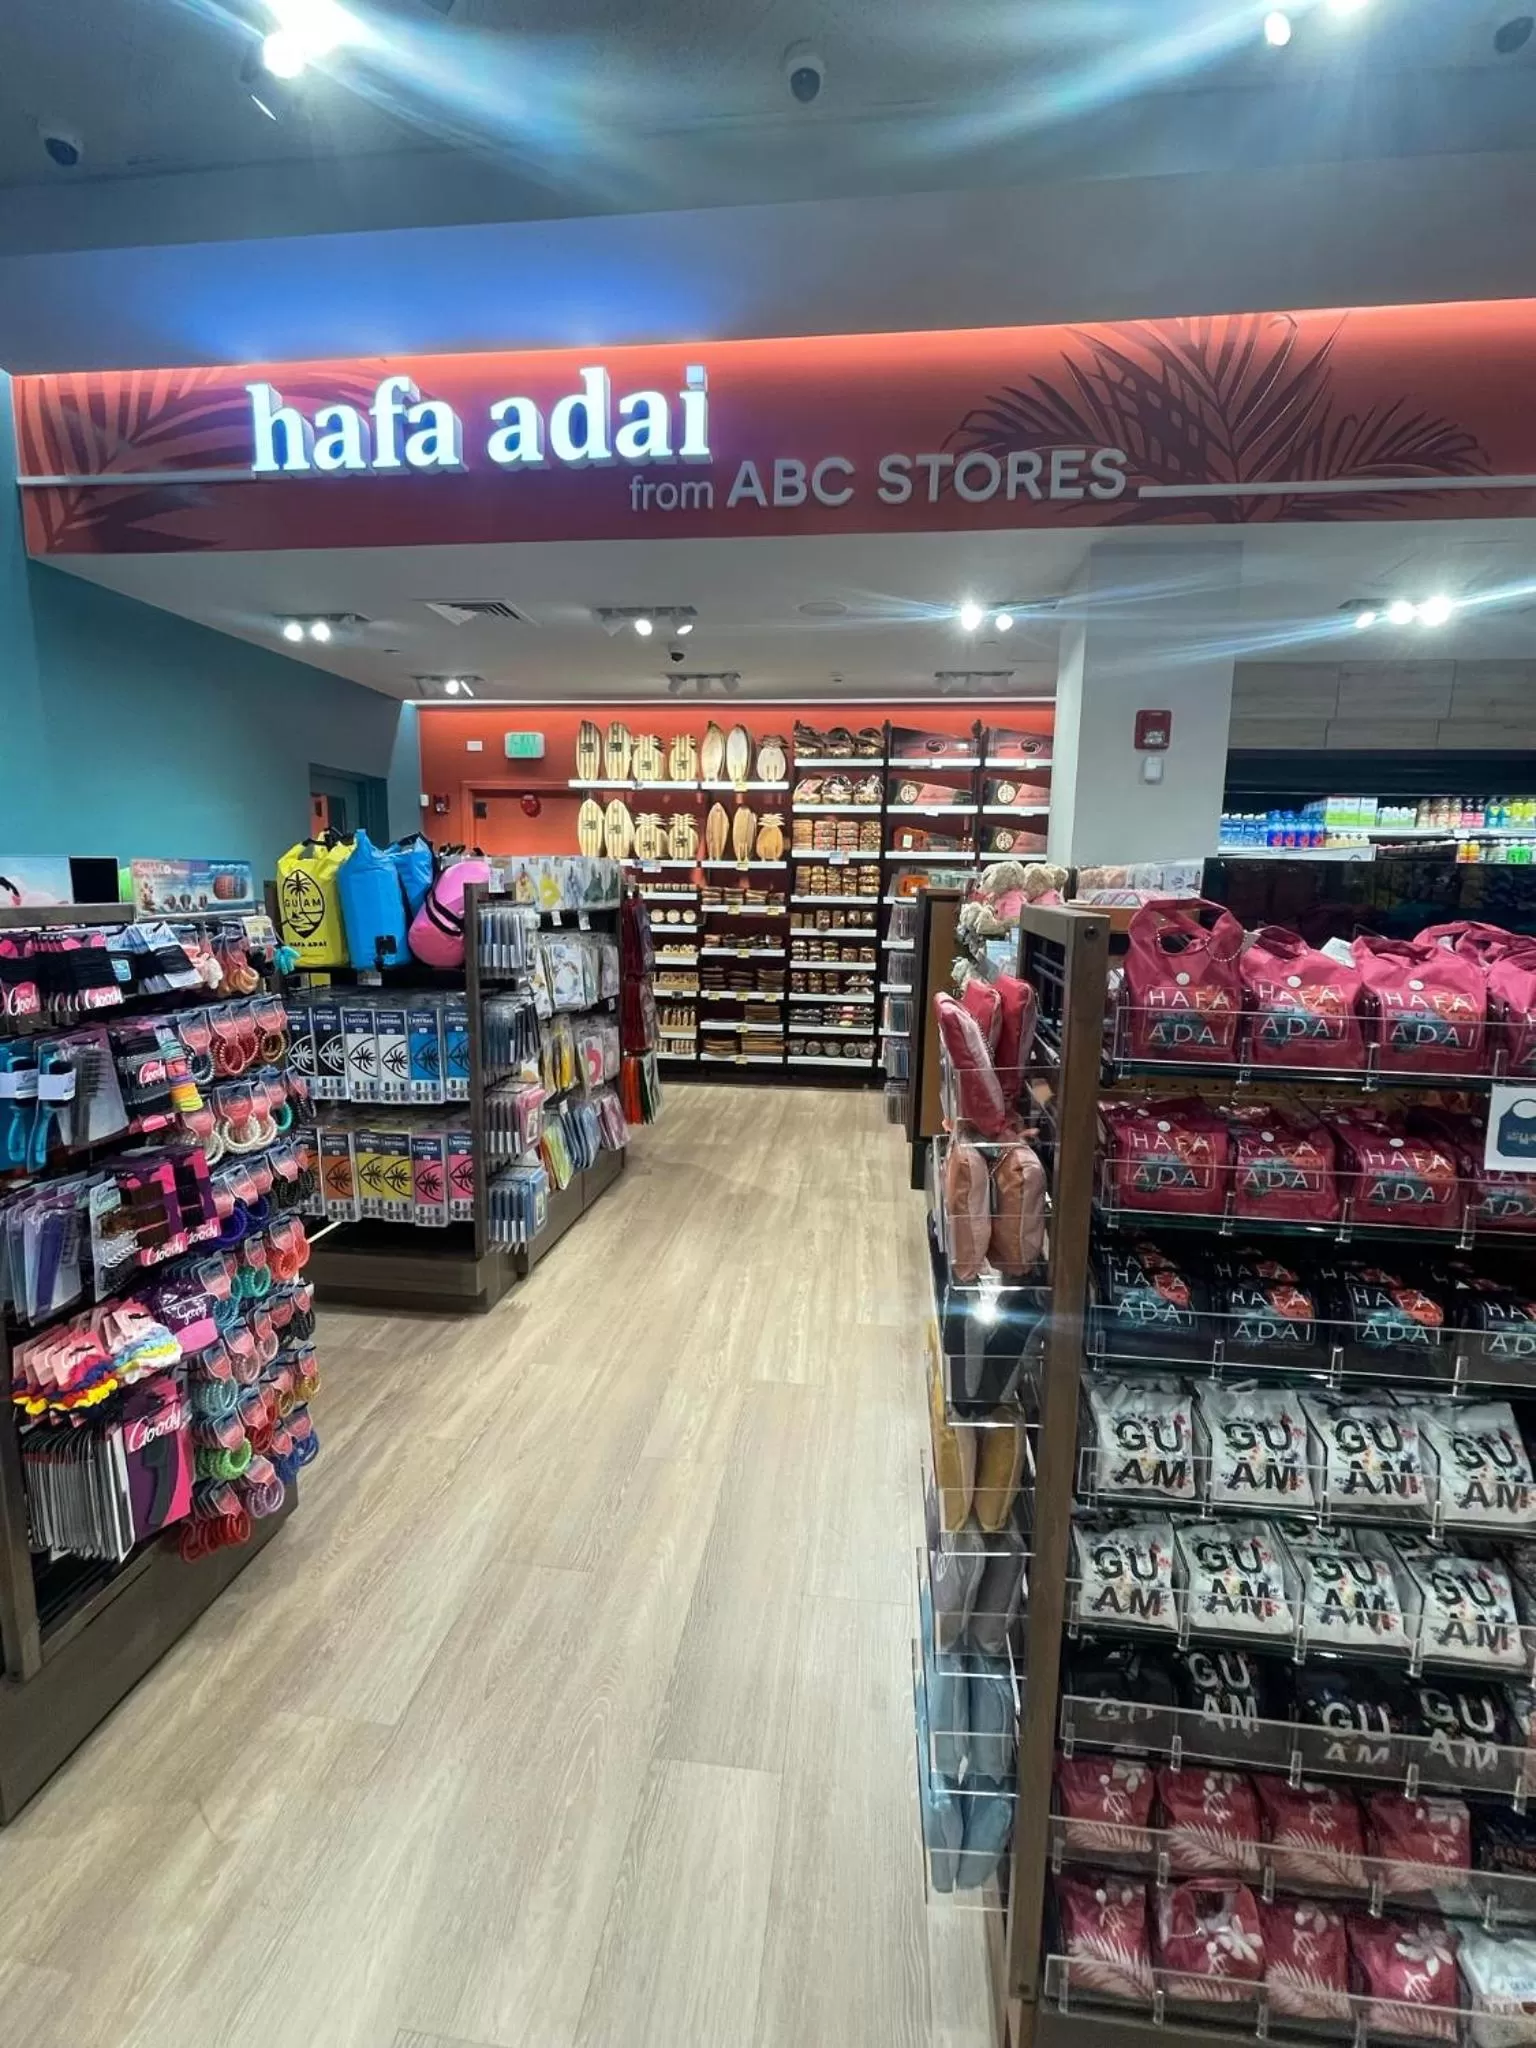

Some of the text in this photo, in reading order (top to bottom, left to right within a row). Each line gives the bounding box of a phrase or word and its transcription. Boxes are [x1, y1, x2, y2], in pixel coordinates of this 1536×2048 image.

[246, 365, 712, 475] hafa adai
[630, 448, 1128, 512] from ABC STORES
[284, 898, 322, 909] GUAM
[1149, 990, 1231, 1010] HAFA
[1258, 984, 1340, 1008] HAFA
[1384, 991, 1473, 1013] HAFA
[1148, 1023, 1229, 1046] ADAI
[1260, 1016, 1343, 1038] ADAI
[1389, 1023, 1475, 1047] ADAI
[1132, 1132, 1211, 1154] HAFA
[1132, 1167, 1210, 1188] ADAI
[1366, 1149, 1453, 1174] HAFA
[1243, 1170, 1321, 1190] ADAI
[1367, 1181, 1452, 1204] ADAI
[1117, 1299, 1194, 1326] ADAI
[1231, 1289, 1311, 1309] HAFA
[1352, 1287, 1437, 1311] HAFA
[1233, 1321, 1312, 1342] ADAI
[1362, 1321, 1443, 1346] ADAI
[129, 1402, 181, 1453] Goody
[1116, 1419, 1184, 1451] GU
[1223, 1418, 1293, 1450] GU
[1335, 1415, 1404, 1454] GU
[1452, 1430, 1518, 1469] GU
[1115, 1459, 1186, 1489] AM
[1226, 1457, 1299, 1493] AM
[1343, 1459, 1418, 1498] AM
[1458, 1476, 1529, 1512] AM
[1092, 1546, 1159, 1580] GU
[1197, 1540, 1264, 1575] GU
[1309, 1555, 1378, 1586] GU
[1094, 1585, 1162, 1618] AM
[1204, 1578, 1274, 1621] AM
[1432, 1571, 1498, 1607] GU
[1320, 1588, 1393, 1634] AM
[1438, 1612, 1510, 1653] AM
[1188, 1652, 1252, 1689] GU
[1202, 1694, 1261, 1738] AM
[1419, 1688, 1496, 1735] GU
[1426, 1727, 1500, 1773] AM
